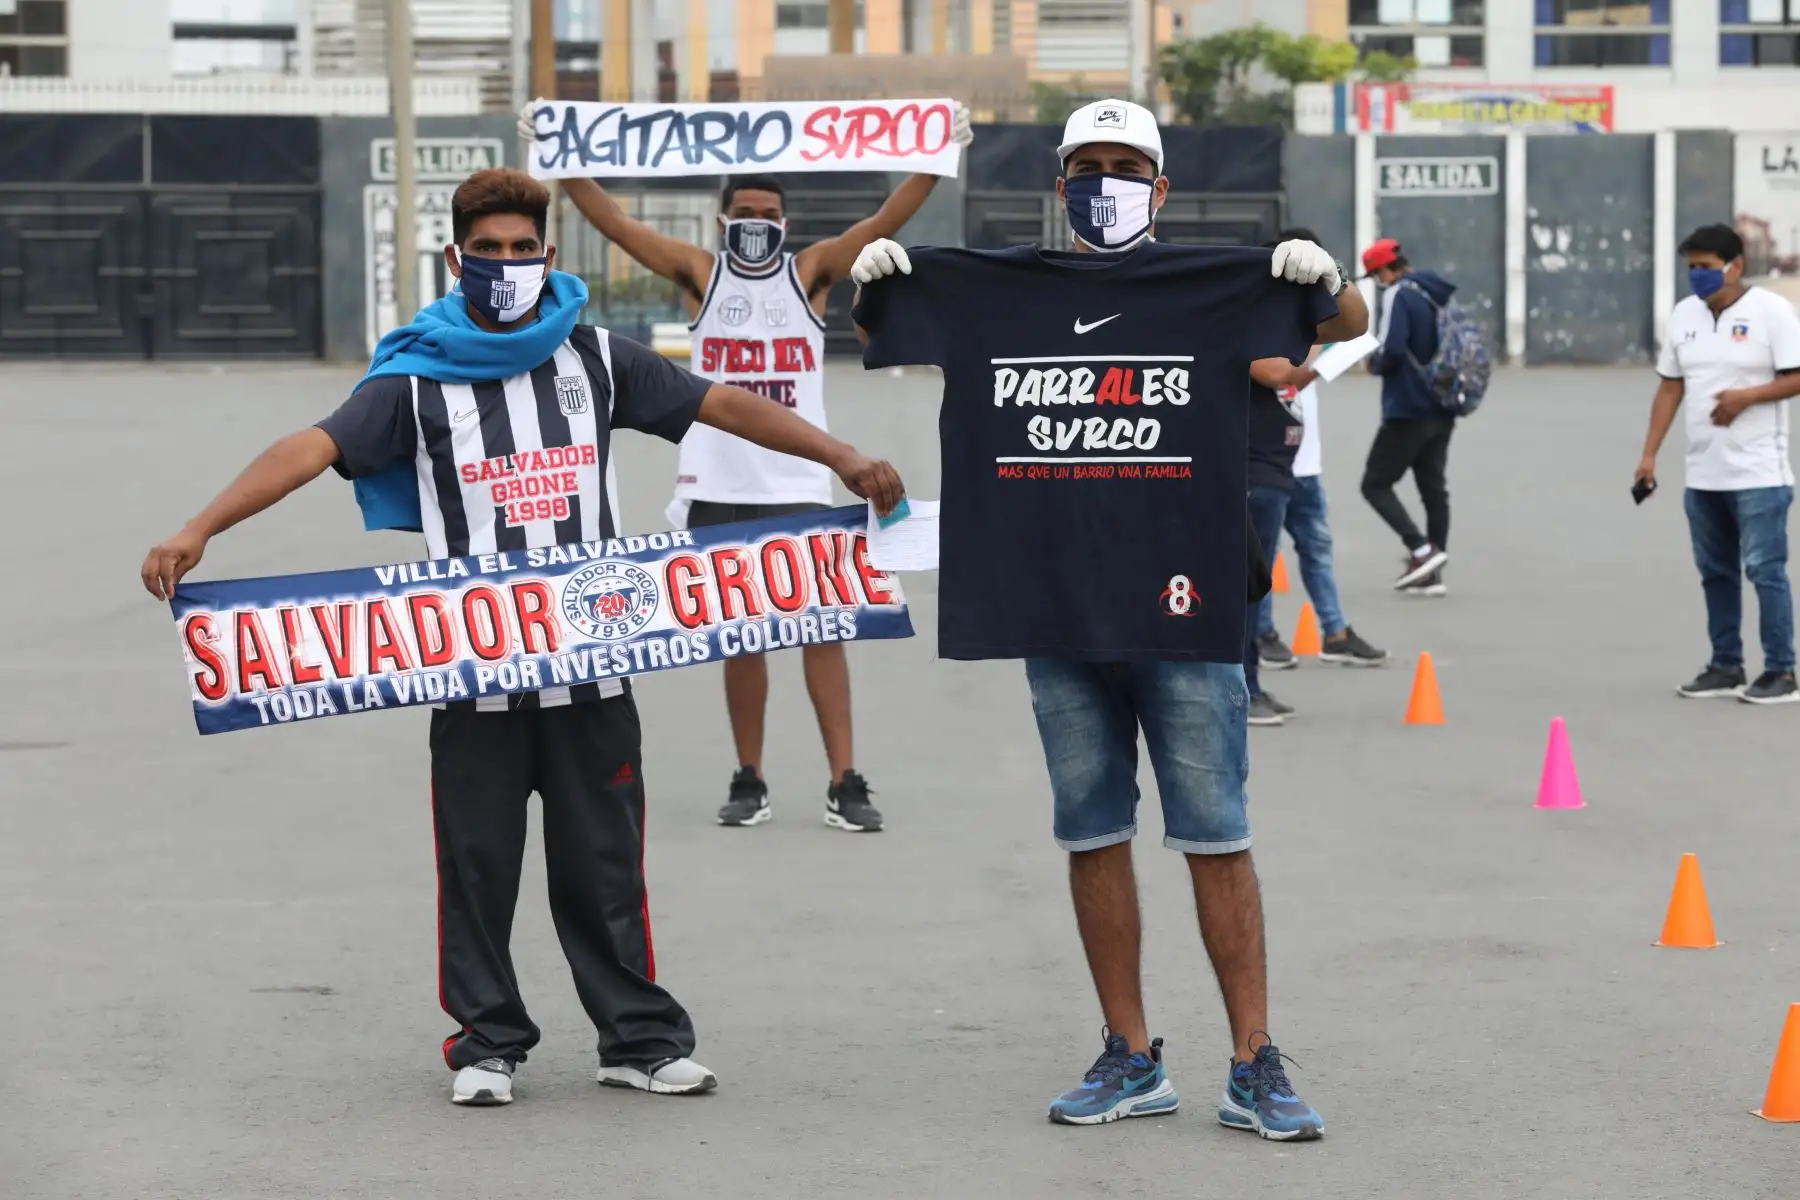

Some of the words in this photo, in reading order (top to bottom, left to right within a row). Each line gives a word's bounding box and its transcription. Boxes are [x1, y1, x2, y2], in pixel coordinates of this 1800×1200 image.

[534, 105, 793, 169] SAGITARIO
[800, 104, 952, 161] SVRCO
[1387, 164, 1484, 187] SALIDA
[702, 336, 766, 373] SVRCO
[725, 380, 797, 408] ONE
[993, 366, 1192, 407] PARRALES
[1027, 414, 1161, 451] SVRCO
[461, 444, 597, 484] SALVADOR
[998, 465, 1024, 478] MAS
[1027, 465, 1050, 479] QVE
[1073, 465, 1114, 479] BARRIO
[1118, 465, 1141, 478] VNA
[1144, 465, 1192, 479] FAMILIA
[491, 471, 579, 504] GRONE
[506, 497, 569, 524] 1998
[375, 557, 470, 586] VILLA
[478, 551, 518, 574] EL
[527, 530, 694, 568] SALVADOR
[564, 564, 617, 621] SALVADOR
[625, 568, 656, 606] GRONE
[598, 593, 625, 614] 20
[1169, 574, 1191, 615] 8
[182, 577, 563, 706] SALVADOR
[662, 529, 895, 633] GRONE
[590, 613, 644, 638] 1998
[251, 685, 338, 725] TODA
[343, 679, 386, 711] LA
[390, 668, 469, 705] VIDA
[475, 658, 543, 694] POR
[550, 631, 710, 685] NVESTROS
[718, 610, 858, 657] COLORES
